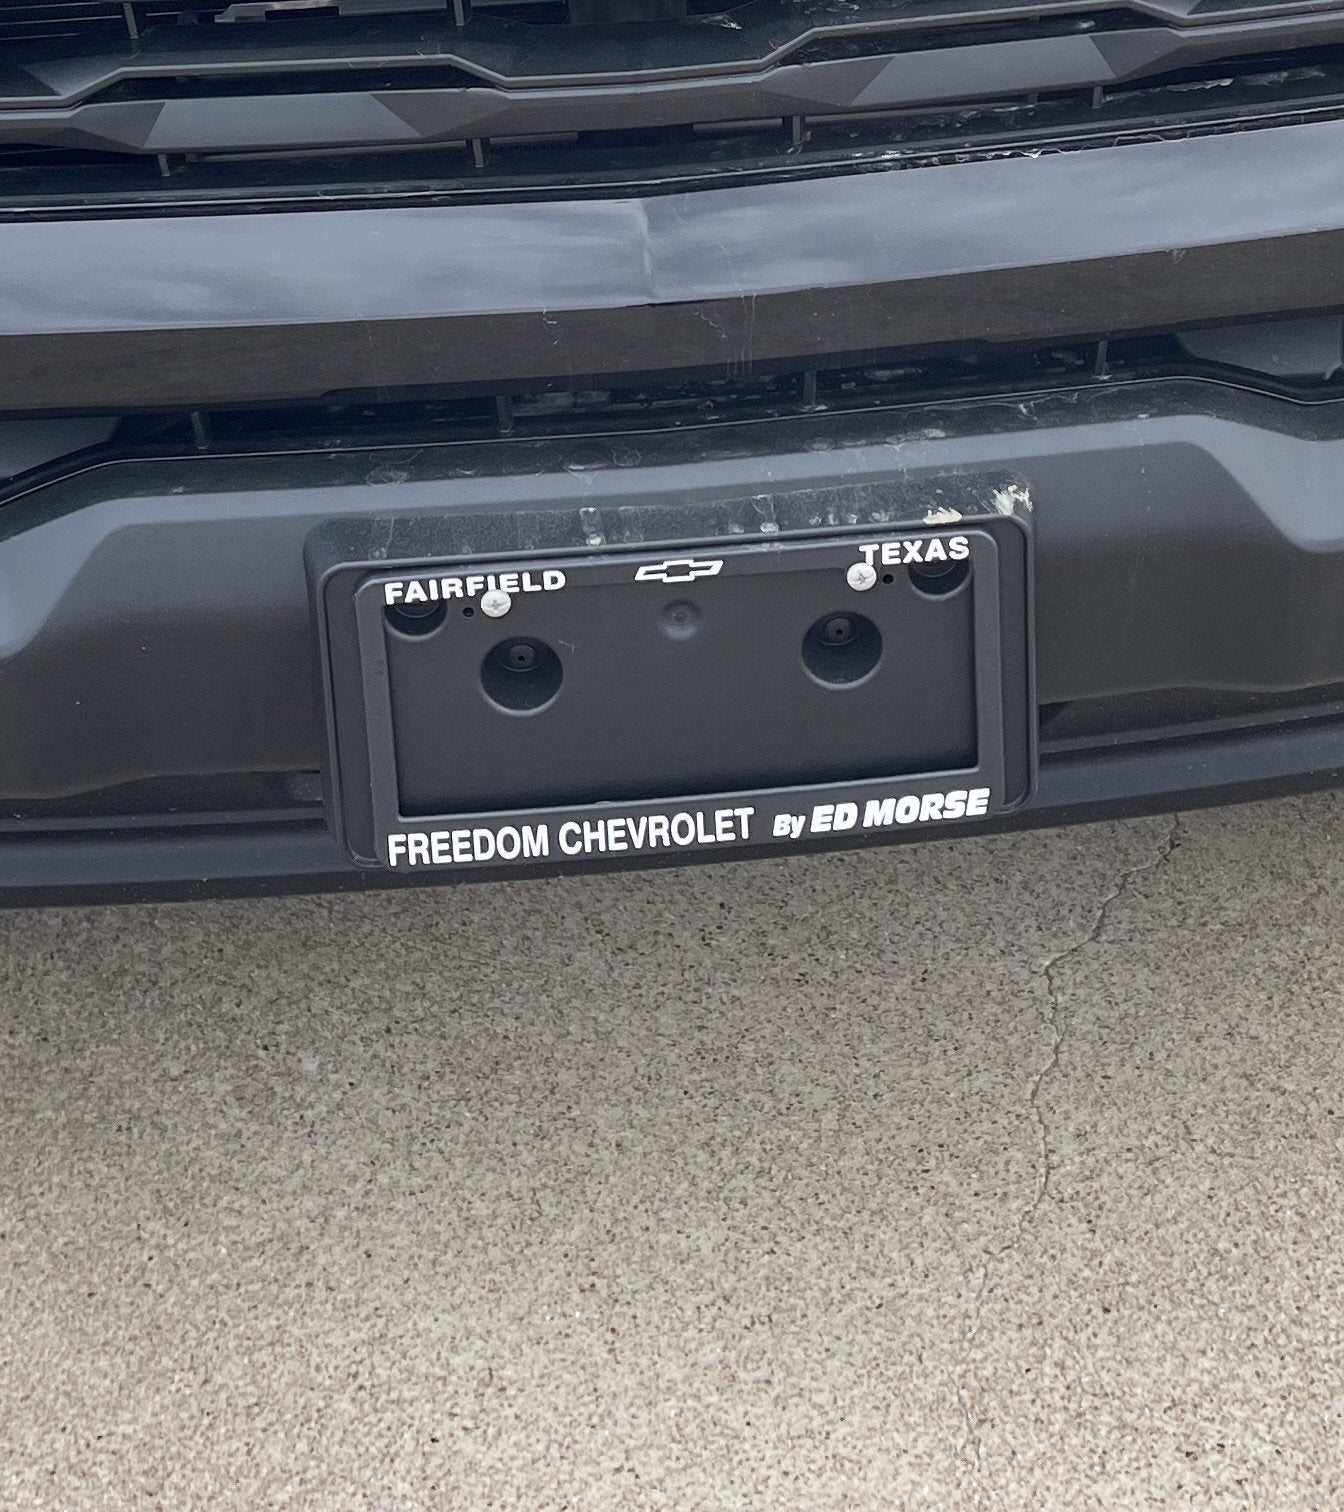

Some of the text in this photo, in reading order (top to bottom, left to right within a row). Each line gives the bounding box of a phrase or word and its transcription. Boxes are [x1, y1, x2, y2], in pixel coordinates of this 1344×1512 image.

[858, 535, 971, 567] TEXAS
[384, 570, 566, 605] FAIRFIELD
[387, 824, 550, 867] FREEDOM
[558, 806, 755, 855] CHEVROLET
[809, 802, 859, 833] ED
[862, 787, 992, 828] MORSE
